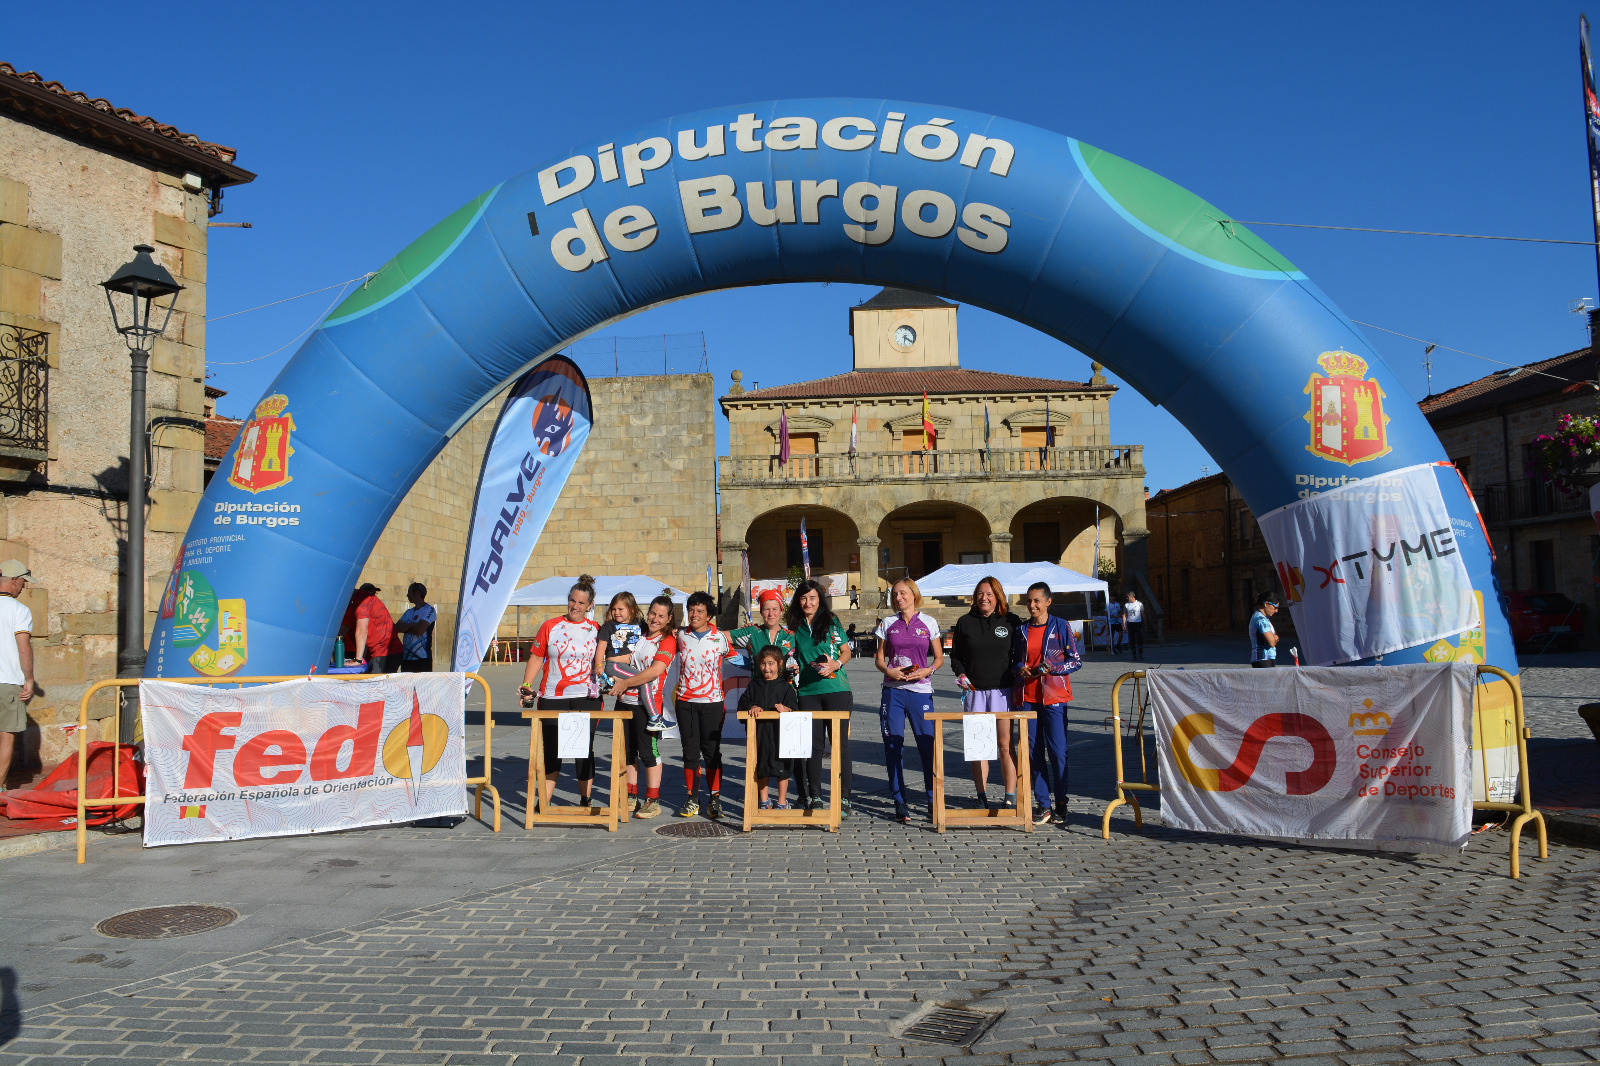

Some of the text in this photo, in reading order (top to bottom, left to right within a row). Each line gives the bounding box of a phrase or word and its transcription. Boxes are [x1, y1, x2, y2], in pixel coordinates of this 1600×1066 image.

[537, 111, 1015, 206] Diputación
[550, 174, 1011, 272] de Burgos
[214, 501, 301, 514] Diputación
[512, 509, 527, 537] 1989
[526, 466, 546, 504] Burgos
[213, 514, 300, 528] de Burgos
[184, 550, 195, 558] PARA
[205, 544, 232, 554] DEPORTE
[186, 534, 246, 549] INSTITUTO PROVINCIAL
[187, 556, 213, 567] JUVENTUD
[1356, 741, 1425, 761] Consejo
[1359, 762, 1432, 781] Superior
[163, 775, 394, 804] Federación Española de Orientación
[1358, 780, 1456, 800] de Deportes
